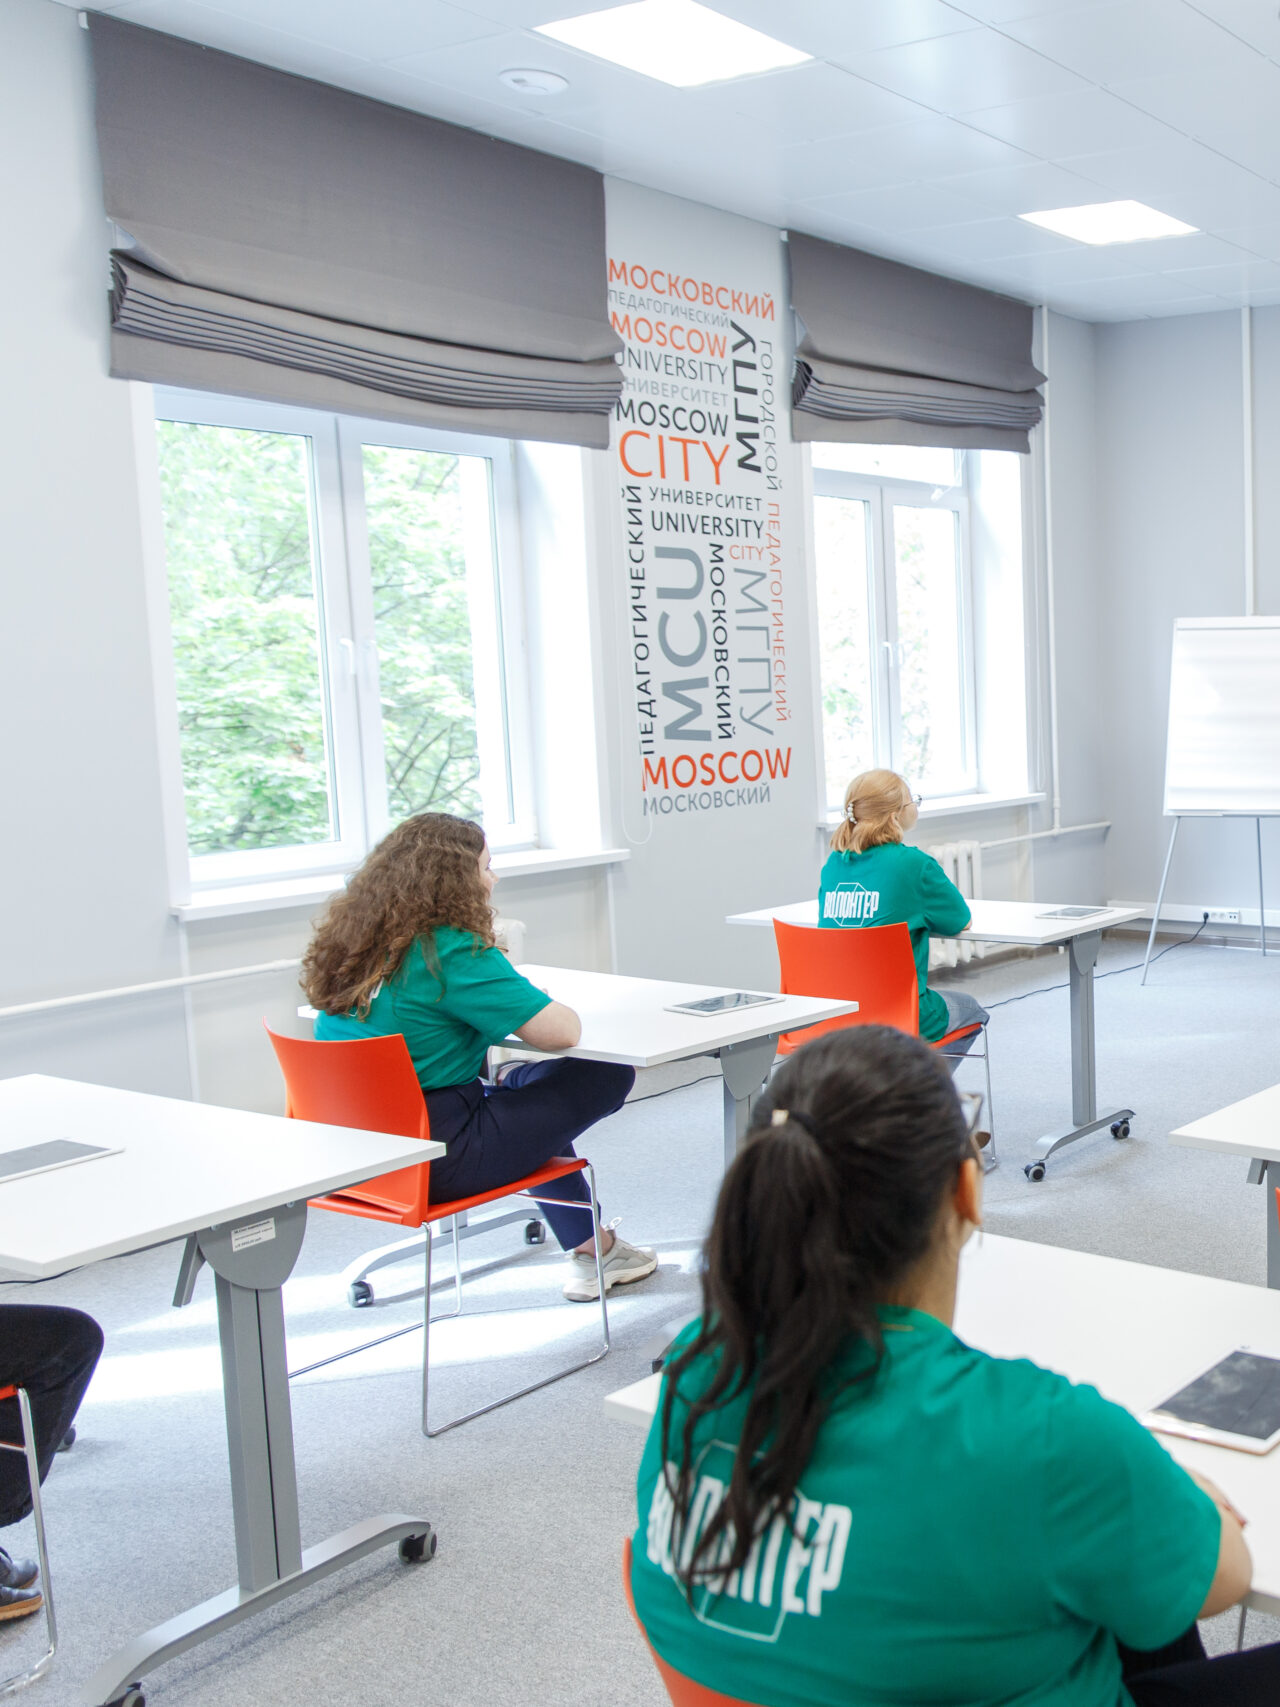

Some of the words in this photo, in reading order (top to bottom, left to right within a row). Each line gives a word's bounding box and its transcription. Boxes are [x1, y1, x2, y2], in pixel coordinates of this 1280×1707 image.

[608, 258, 775, 321] МОСКОВСКИЙ
[608, 289, 730, 329] ПЕДАГОГИЧЕСКИЙ
[611, 311, 727, 359] MOSCOW
[624, 376, 728, 407] НИВЕРСИТЕТ
[730, 320, 762, 473] МГПУ
[760, 340, 782, 490] ГОРОДСКОЙ
[616, 397, 728, 436] MOSCOW
[619, 430, 730, 485] CITY
[649, 486, 762, 511] УНИВЕРСИТЕТ
[651, 510, 763, 539] UNIVERSITY
[729, 544, 764, 561] CITY
[621, 485, 657, 755] ПЕДАГОГИЧЕСКИЙ
[765, 502, 791, 722] ПЕДАГОГИЧЕСКИЙ
[654, 546, 712, 742] MCU
[709, 542, 736, 740] МОСКОВСКИЙ
[733, 568, 774, 736] МГПУ
[642, 747, 792, 791] MOSCOW
[643, 782, 771, 816] МОСКОВСКИЙ
[823, 891, 880, 919] ВОЛОНТЕР
